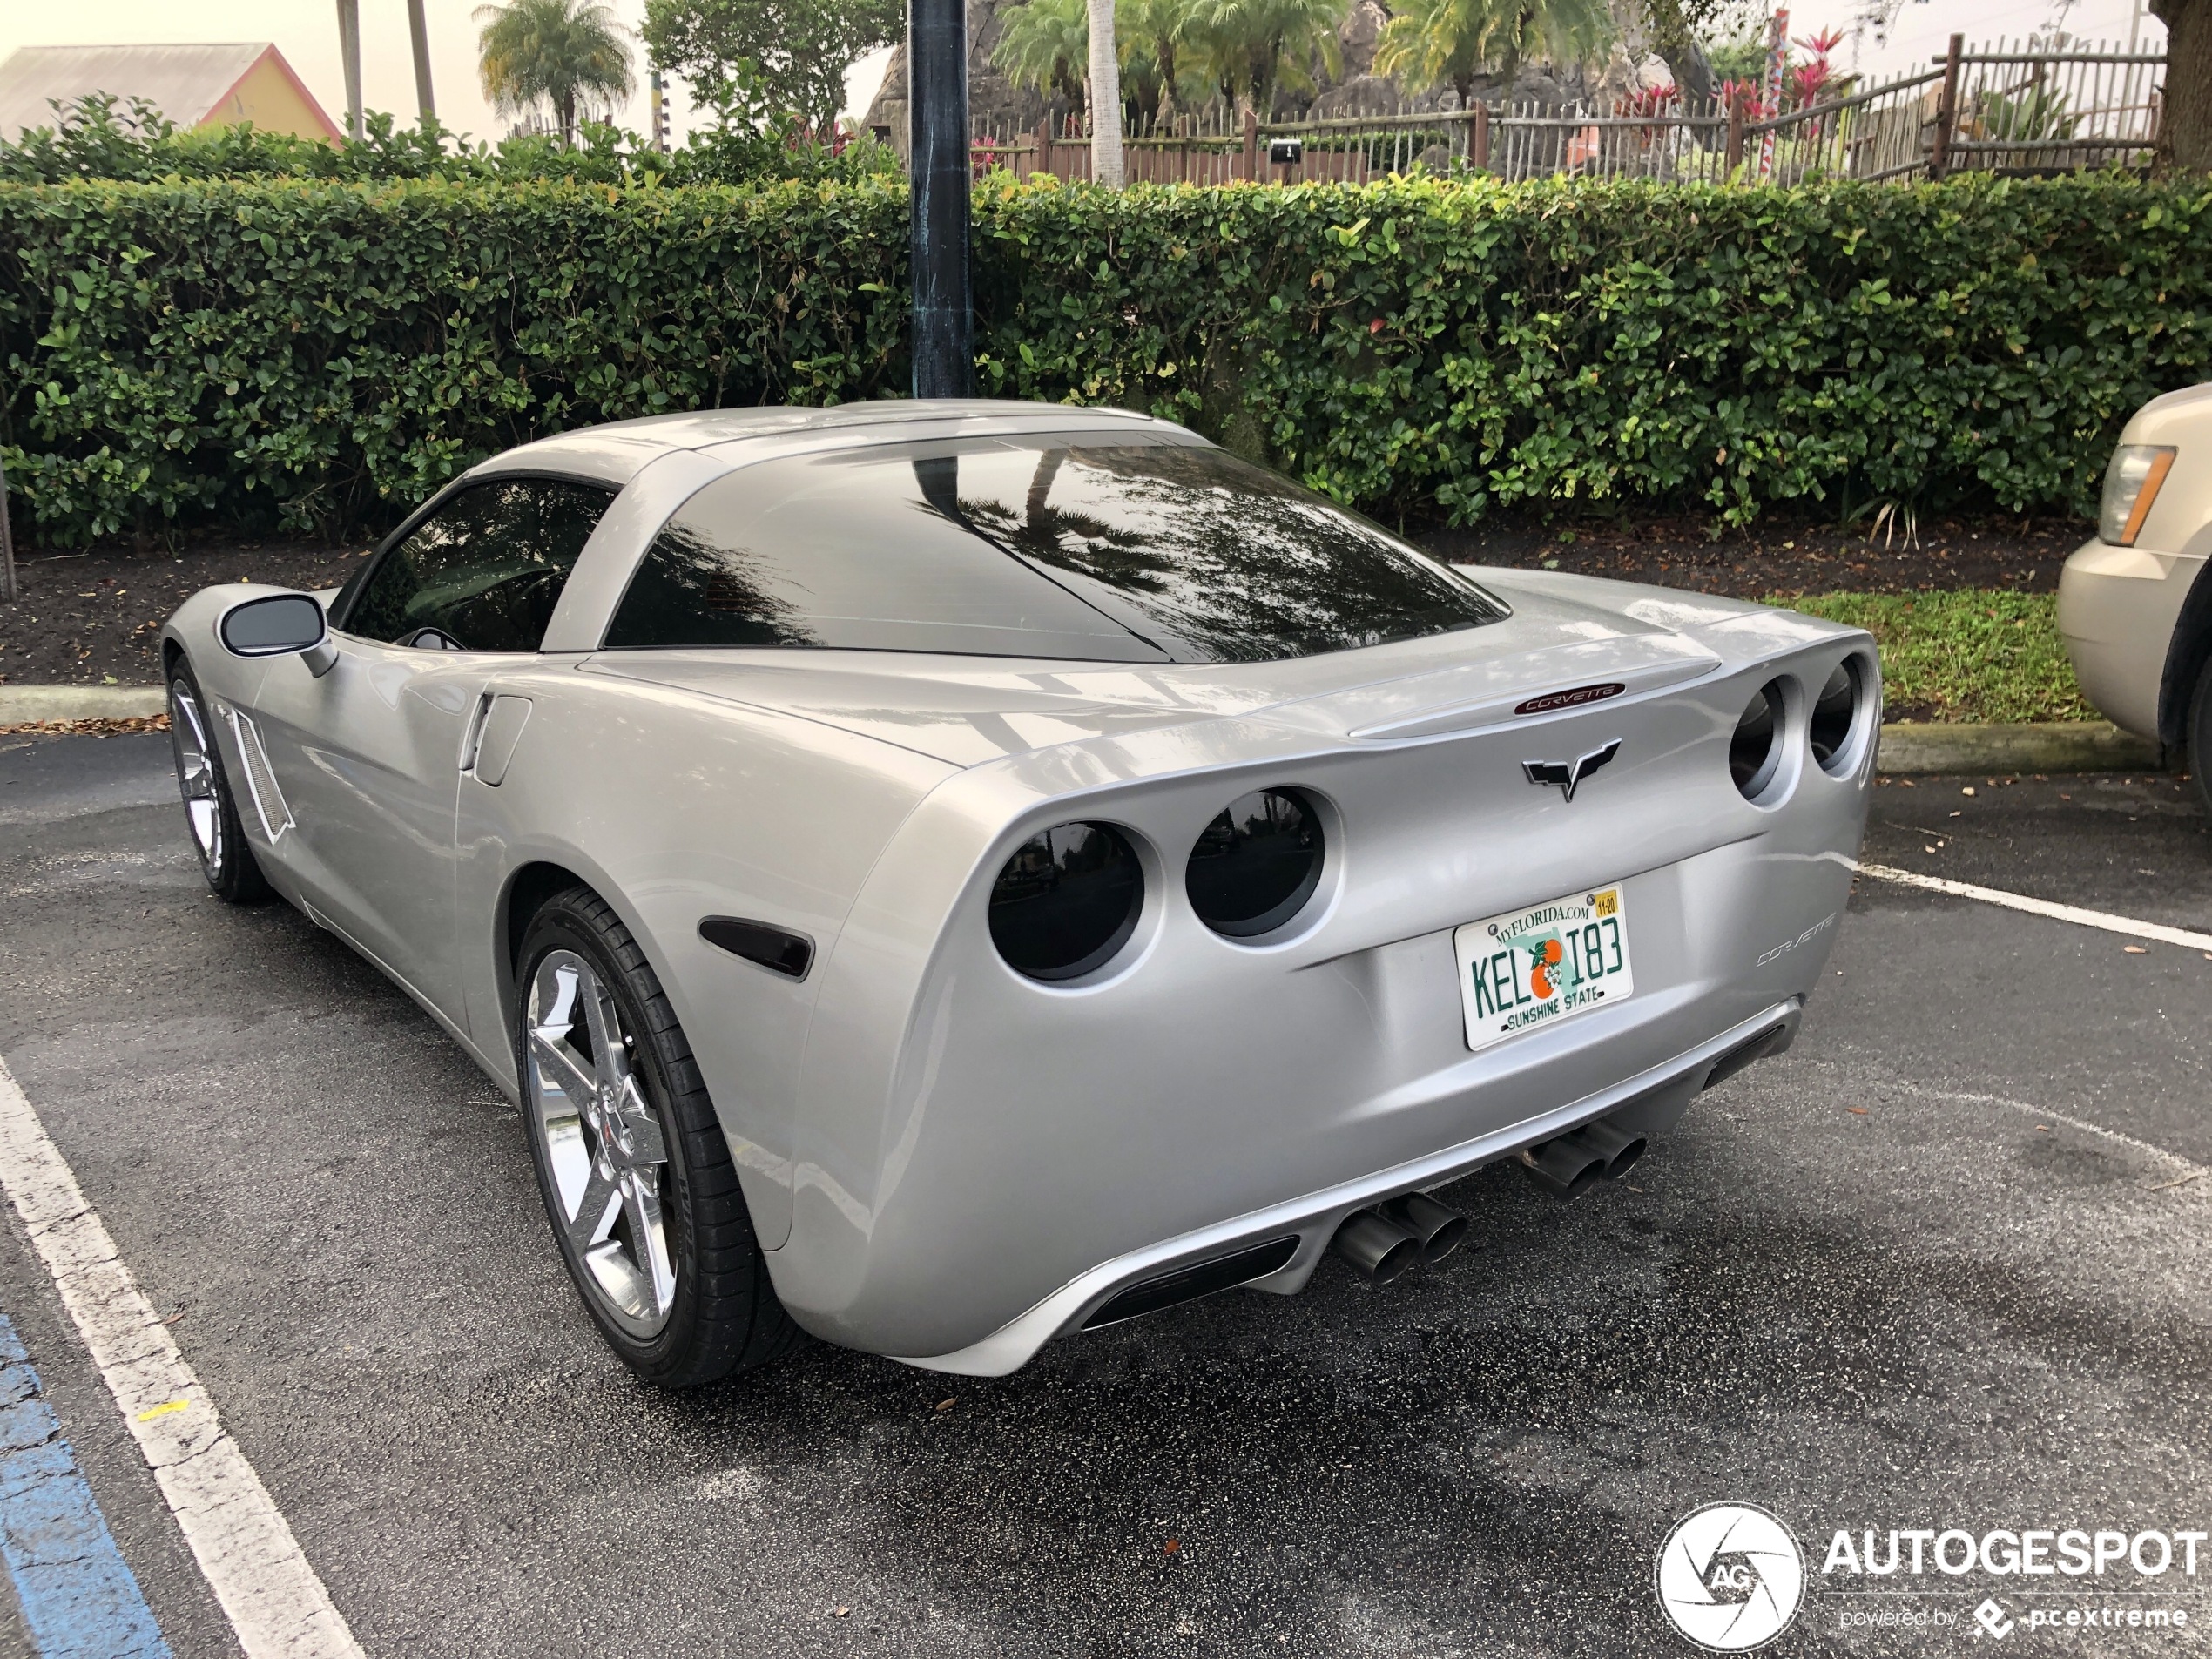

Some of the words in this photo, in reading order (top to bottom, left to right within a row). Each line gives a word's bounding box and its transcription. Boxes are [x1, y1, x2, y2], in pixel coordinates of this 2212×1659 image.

[1526, 685, 1615, 711] CORVETTE
[1598, 897, 1615, 916] 11-20
[1756, 911, 1837, 968] CORVETTE
[1471, 949, 1532, 1019] KEL
[1566, 917, 1623, 986] I83
[1507, 998, 1560, 1030] SUNSHINE
[1564, 986, 1599, 1010] STATE
